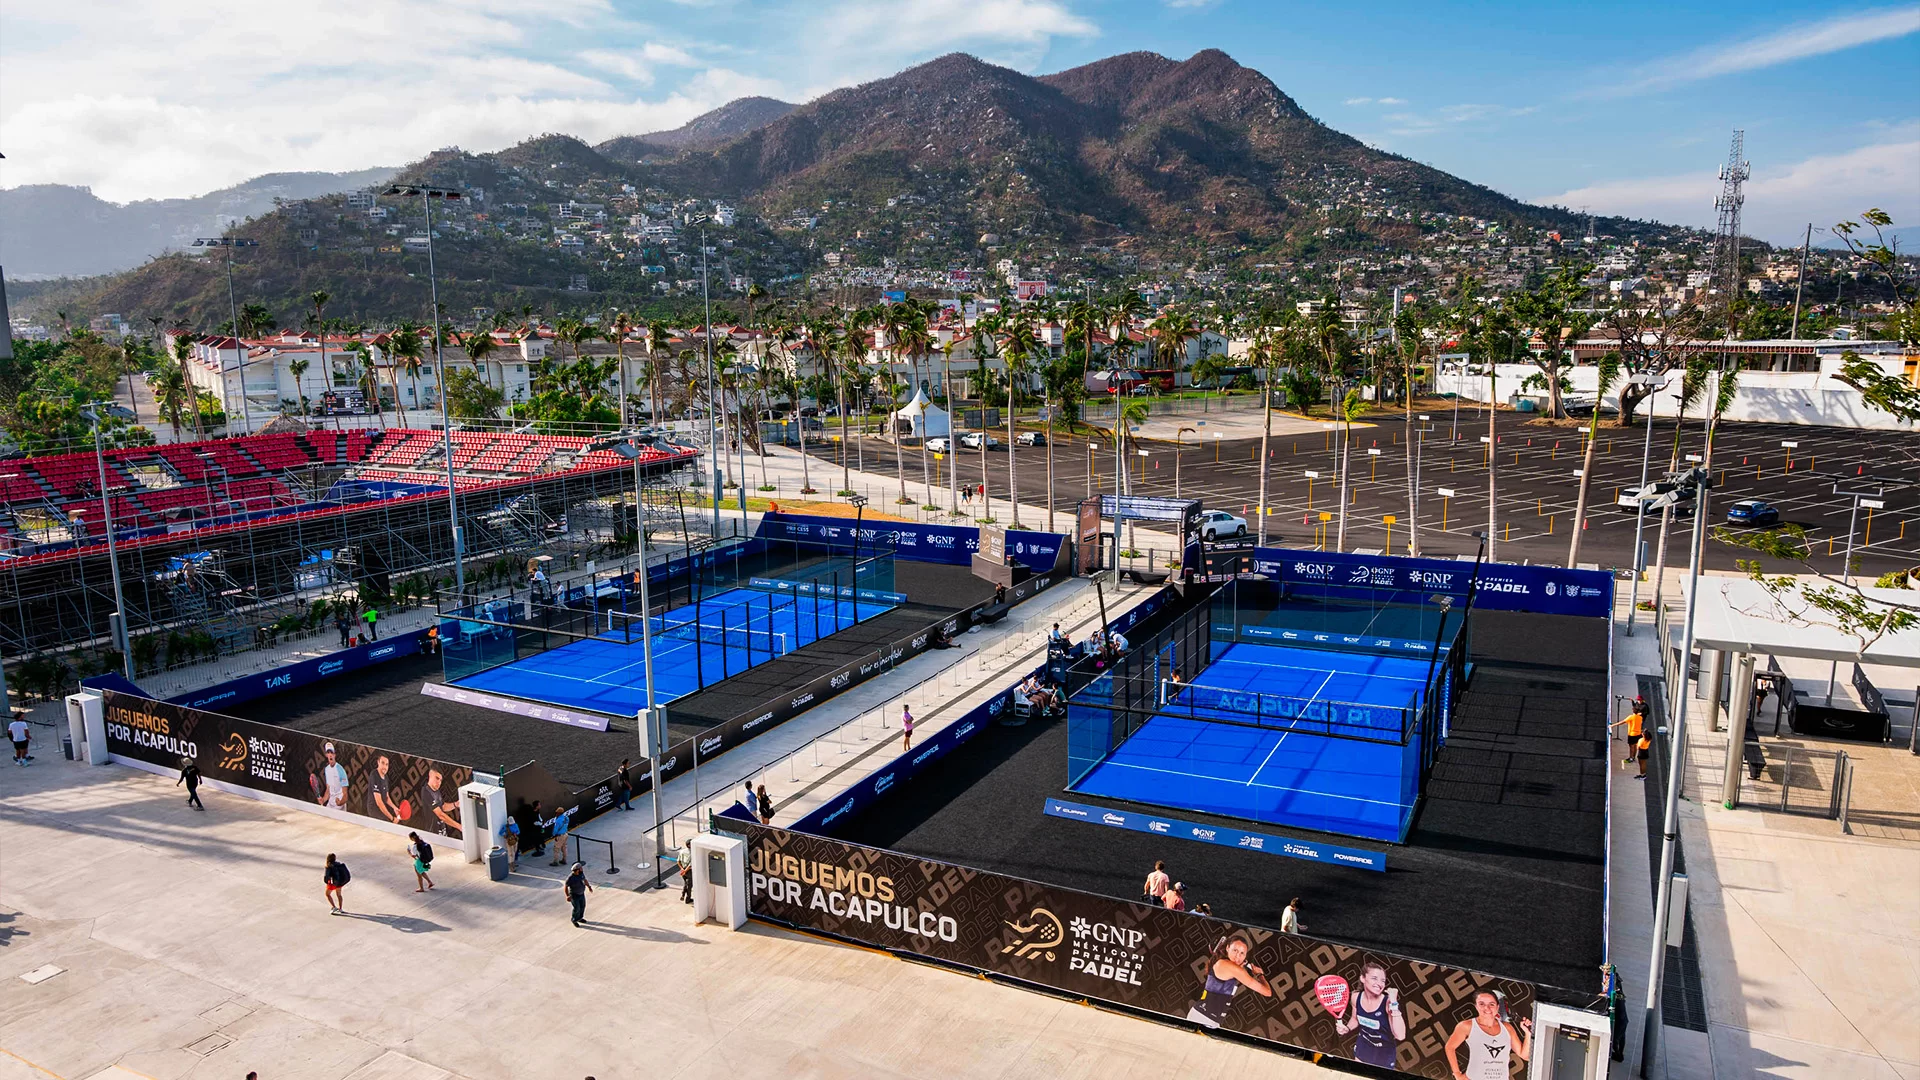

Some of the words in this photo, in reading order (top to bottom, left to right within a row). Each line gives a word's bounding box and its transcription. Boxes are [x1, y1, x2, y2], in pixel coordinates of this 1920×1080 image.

[935, 535, 955, 545] GNP
[1306, 563, 1333, 575] GNP
[1423, 572, 1452, 584] GNP
[1484, 583, 1530, 594] PADEL
[265, 673, 292, 689] TANE
[836, 671, 850, 684] GNP
[194, 691, 236, 708] CUPRA
[1218, 694, 1338, 723] ACAPULCO
[1347, 707, 1371, 726] P1
[106, 705, 170, 735] JUGUEMOS
[107, 722, 131, 743] POR
[134, 729, 198, 759] ACAPULCO
[260, 739, 285, 757] GNP
[251, 765, 287, 783] PADEL
[1199, 829, 1216, 838] GNP
[1292, 849, 1319, 858] PADEL
[1333, 853, 1374, 865] POWERADE
[750, 849, 895, 902] JUGUEMOS
[752, 872, 802, 907] POR
[810, 887, 957, 943] ACAPULCO
[1093, 923, 1143, 949] GNP
[1073, 950, 1143, 971] PREMIER
[1069, 957, 1142, 986] PADEL
